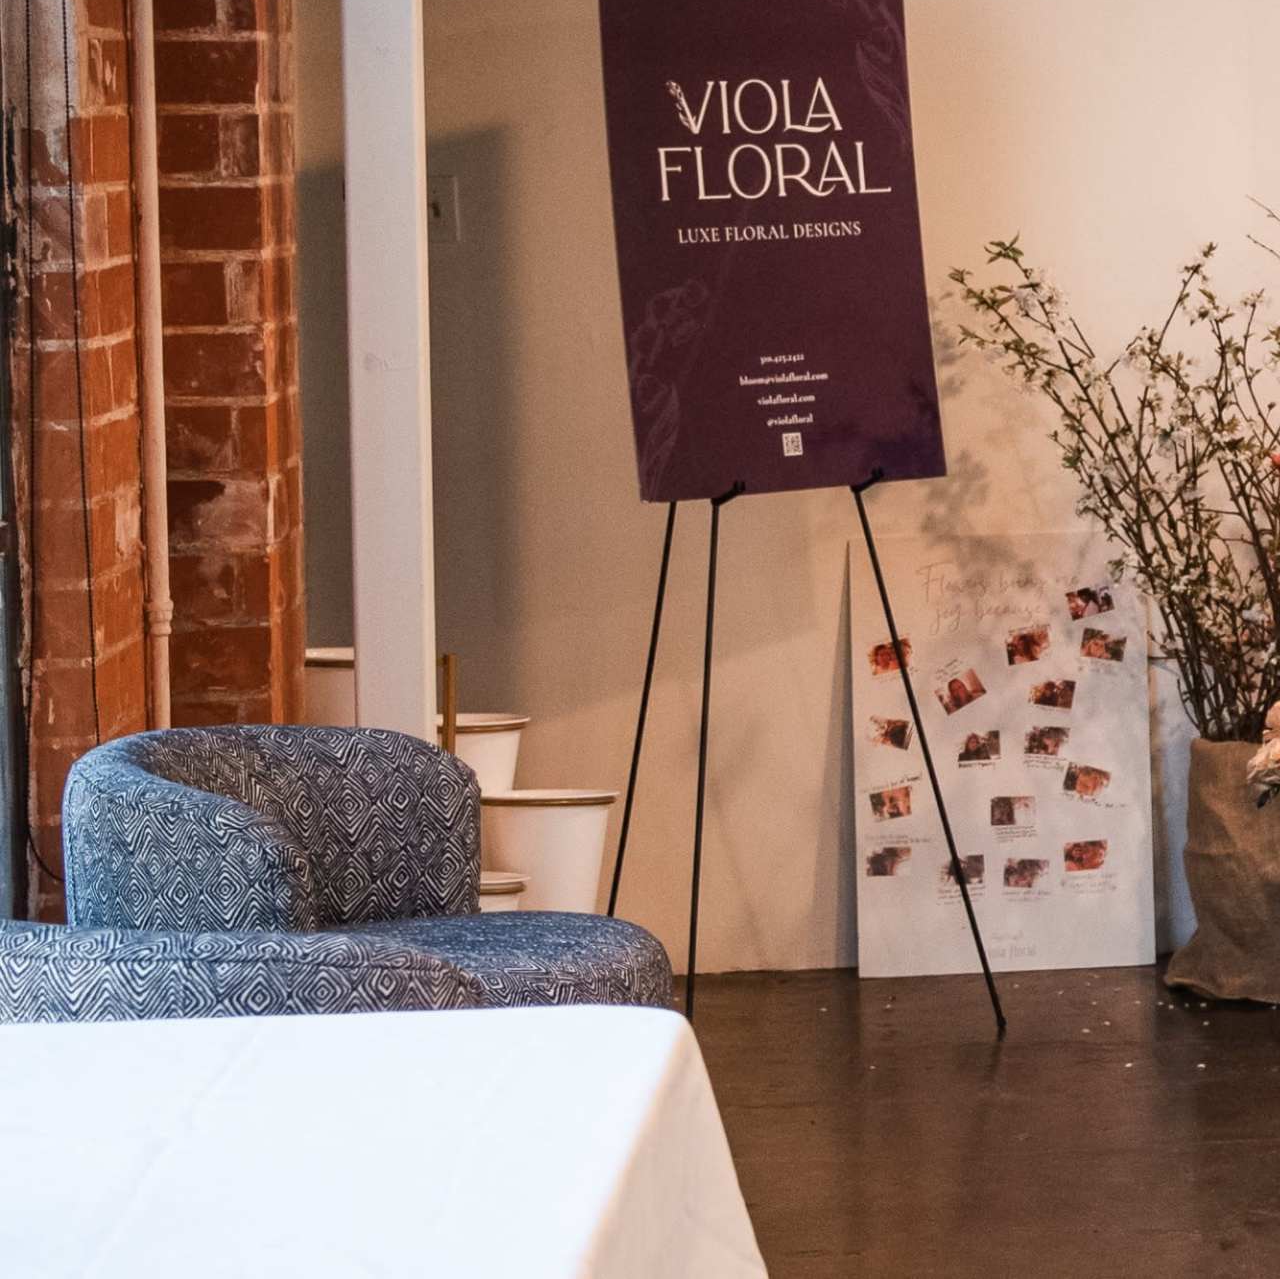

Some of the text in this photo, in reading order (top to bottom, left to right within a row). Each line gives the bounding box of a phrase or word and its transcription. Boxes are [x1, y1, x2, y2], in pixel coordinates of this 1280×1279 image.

[666, 76, 843, 135] VIOLA
[657, 140, 892, 202] FLORAL
[677, 220, 862, 244] LUXE FLORAL DESIGNS
[757, 393, 816, 405] violafloral.com
[767, 413, 814, 427] @violafloral
